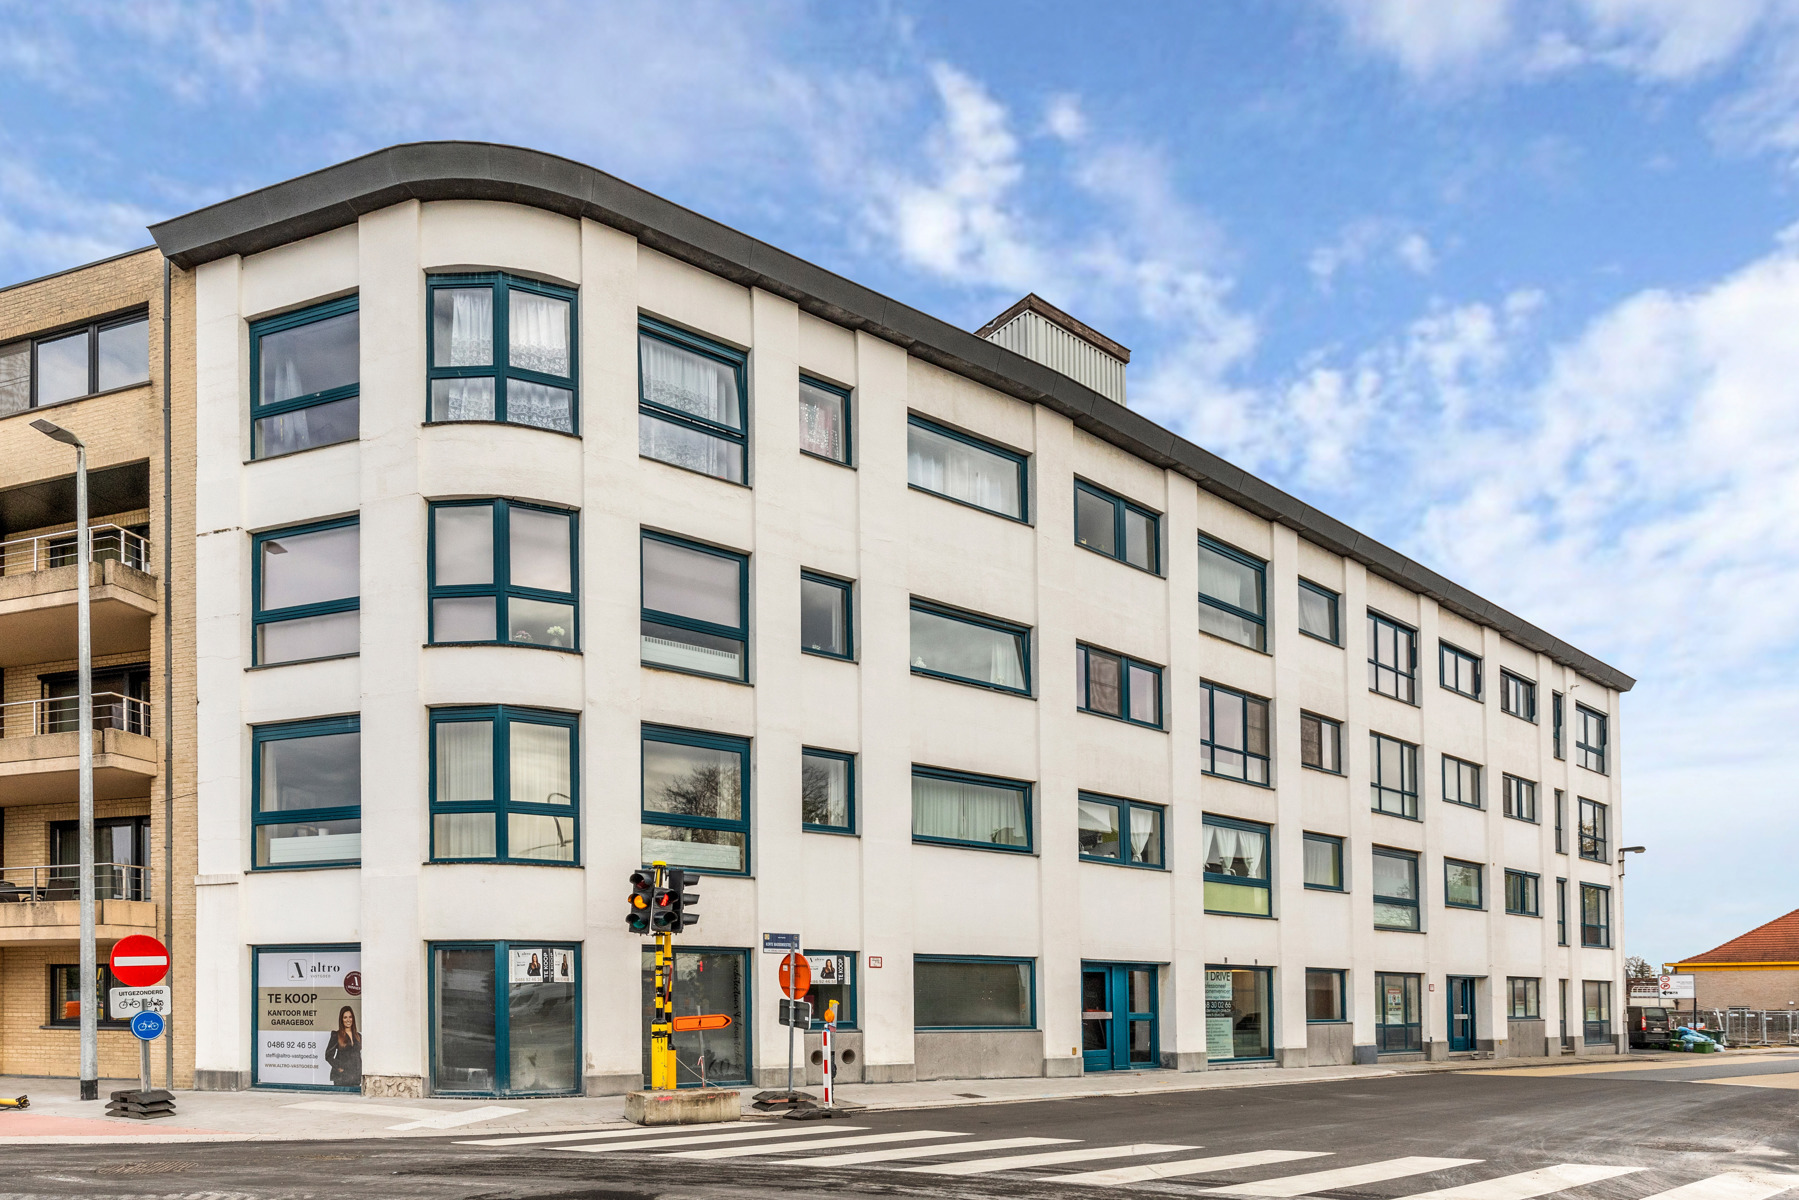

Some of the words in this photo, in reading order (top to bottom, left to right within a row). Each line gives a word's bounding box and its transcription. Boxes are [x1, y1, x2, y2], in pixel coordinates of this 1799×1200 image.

[310, 961, 340, 973] altro
[543, 970, 549, 978] TE
[1210, 971, 1231, 981] DRIVE
[118, 989, 164, 997] UITGEZONDERD
[267, 993, 282, 1004] TE
[284, 993, 318, 1004] KOOP
[1210, 1001, 1217, 1009] 30
[1217, 1001, 1224, 1009] 02
[1224, 1001, 1231, 1009] 66
[267, 1009, 301, 1017] KANTOOR
[302, 1009, 318, 1017] MET
[267, 1041, 285, 1049] 0486
[286, 1041, 295, 1049] 92
[296, 1041, 306, 1049] 46
